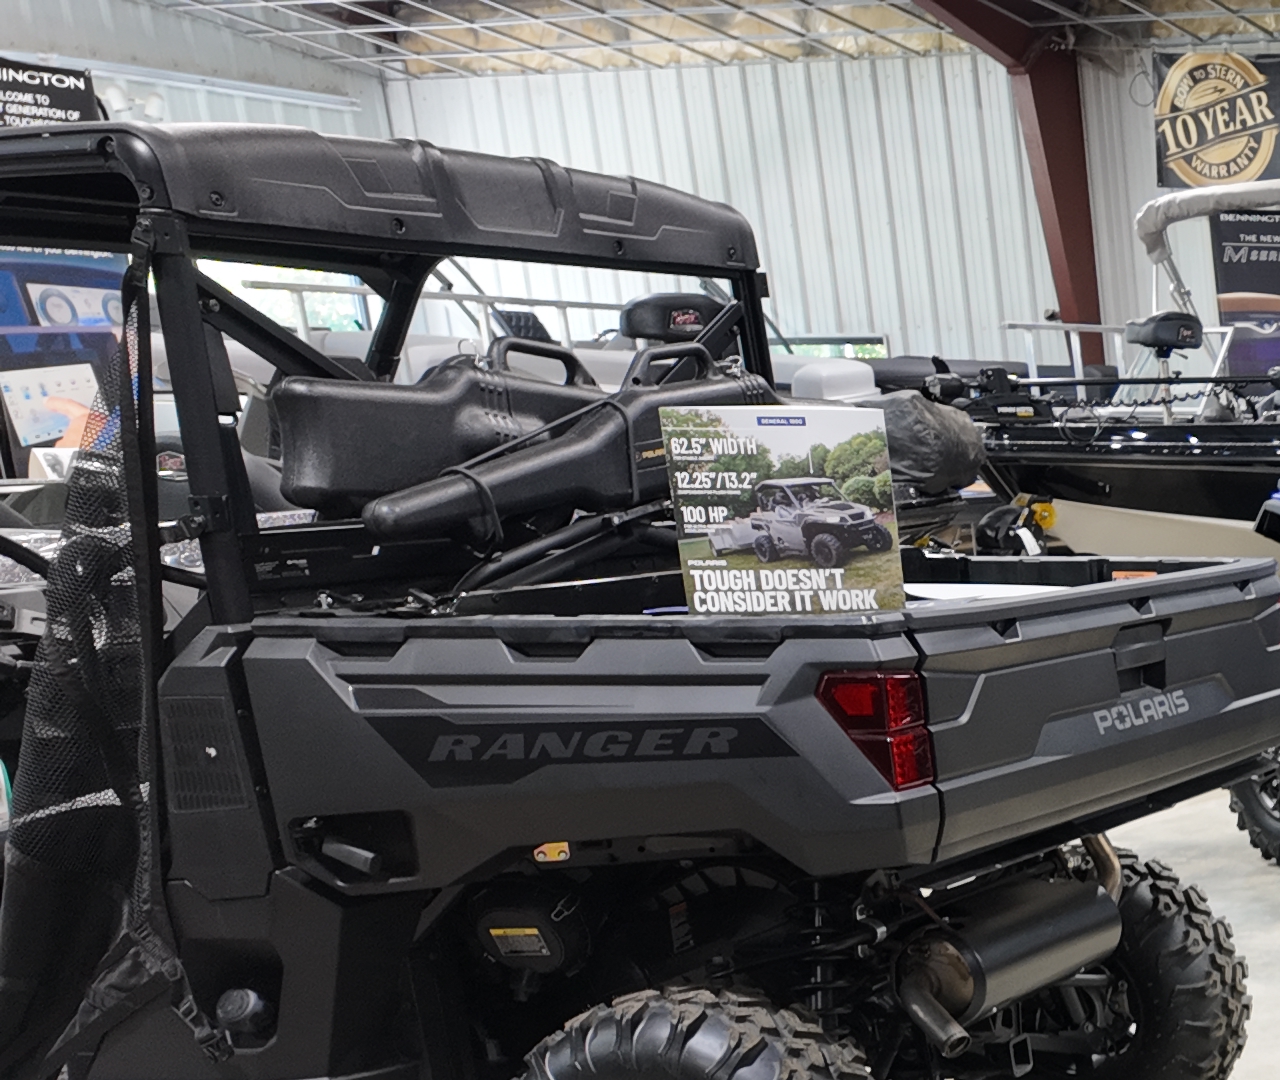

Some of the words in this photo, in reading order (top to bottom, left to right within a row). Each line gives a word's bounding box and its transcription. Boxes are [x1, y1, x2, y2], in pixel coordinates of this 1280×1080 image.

[0, 67, 86, 91] INGTON
[1173, 72, 1195, 109] BOW
[1193, 68, 1206, 80] TO
[1206, 63, 1245, 89] STERN
[35, 93, 50, 106] TO
[1157, 114, 1198, 156] 10
[1197, 90, 1275, 141] YEAR
[1191, 136, 1259, 178] WARRANTY
[1239, 234, 1257, 243] THE
[708, 437, 757, 455] WIDTH
[680, 505, 706, 523] 100
[708, 505, 728, 523] HP
[689, 569, 757, 591] TOUGH
[759, 568, 845, 591] DOESN'T
[693, 590, 791, 612] CONSIDER
[794, 590, 814, 611] IT
[818, 588, 879, 610] WORK
[1093, 689, 1190, 735] POLARIS
[427, 726, 739, 763] RANGER
